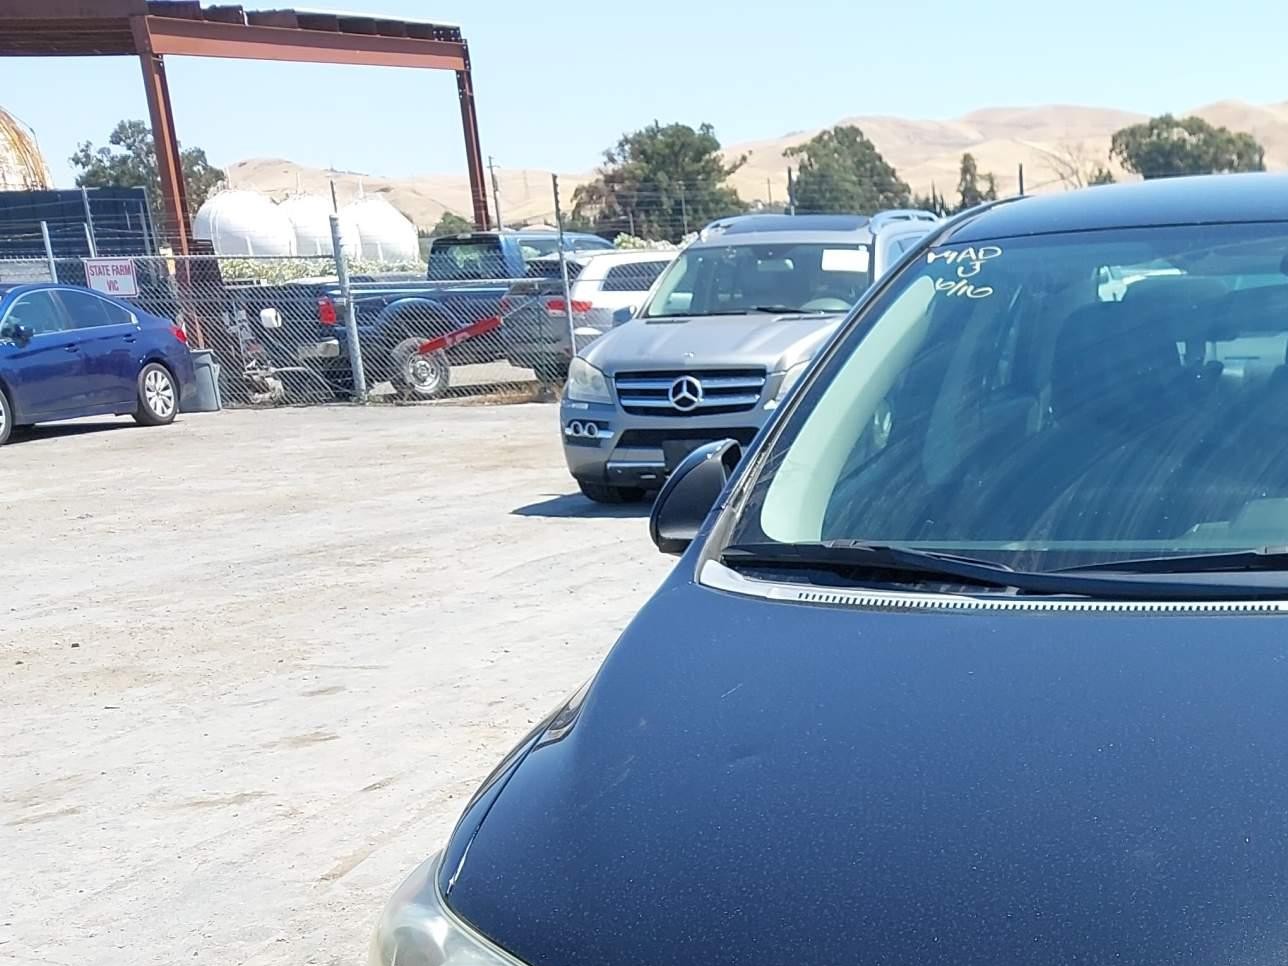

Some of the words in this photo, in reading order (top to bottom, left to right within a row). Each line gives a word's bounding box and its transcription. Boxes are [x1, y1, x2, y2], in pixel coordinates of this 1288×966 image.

[89, 264, 110, 276] STATE
[111, 264, 131, 276] FARM
[106, 279, 119, 291] VIC
